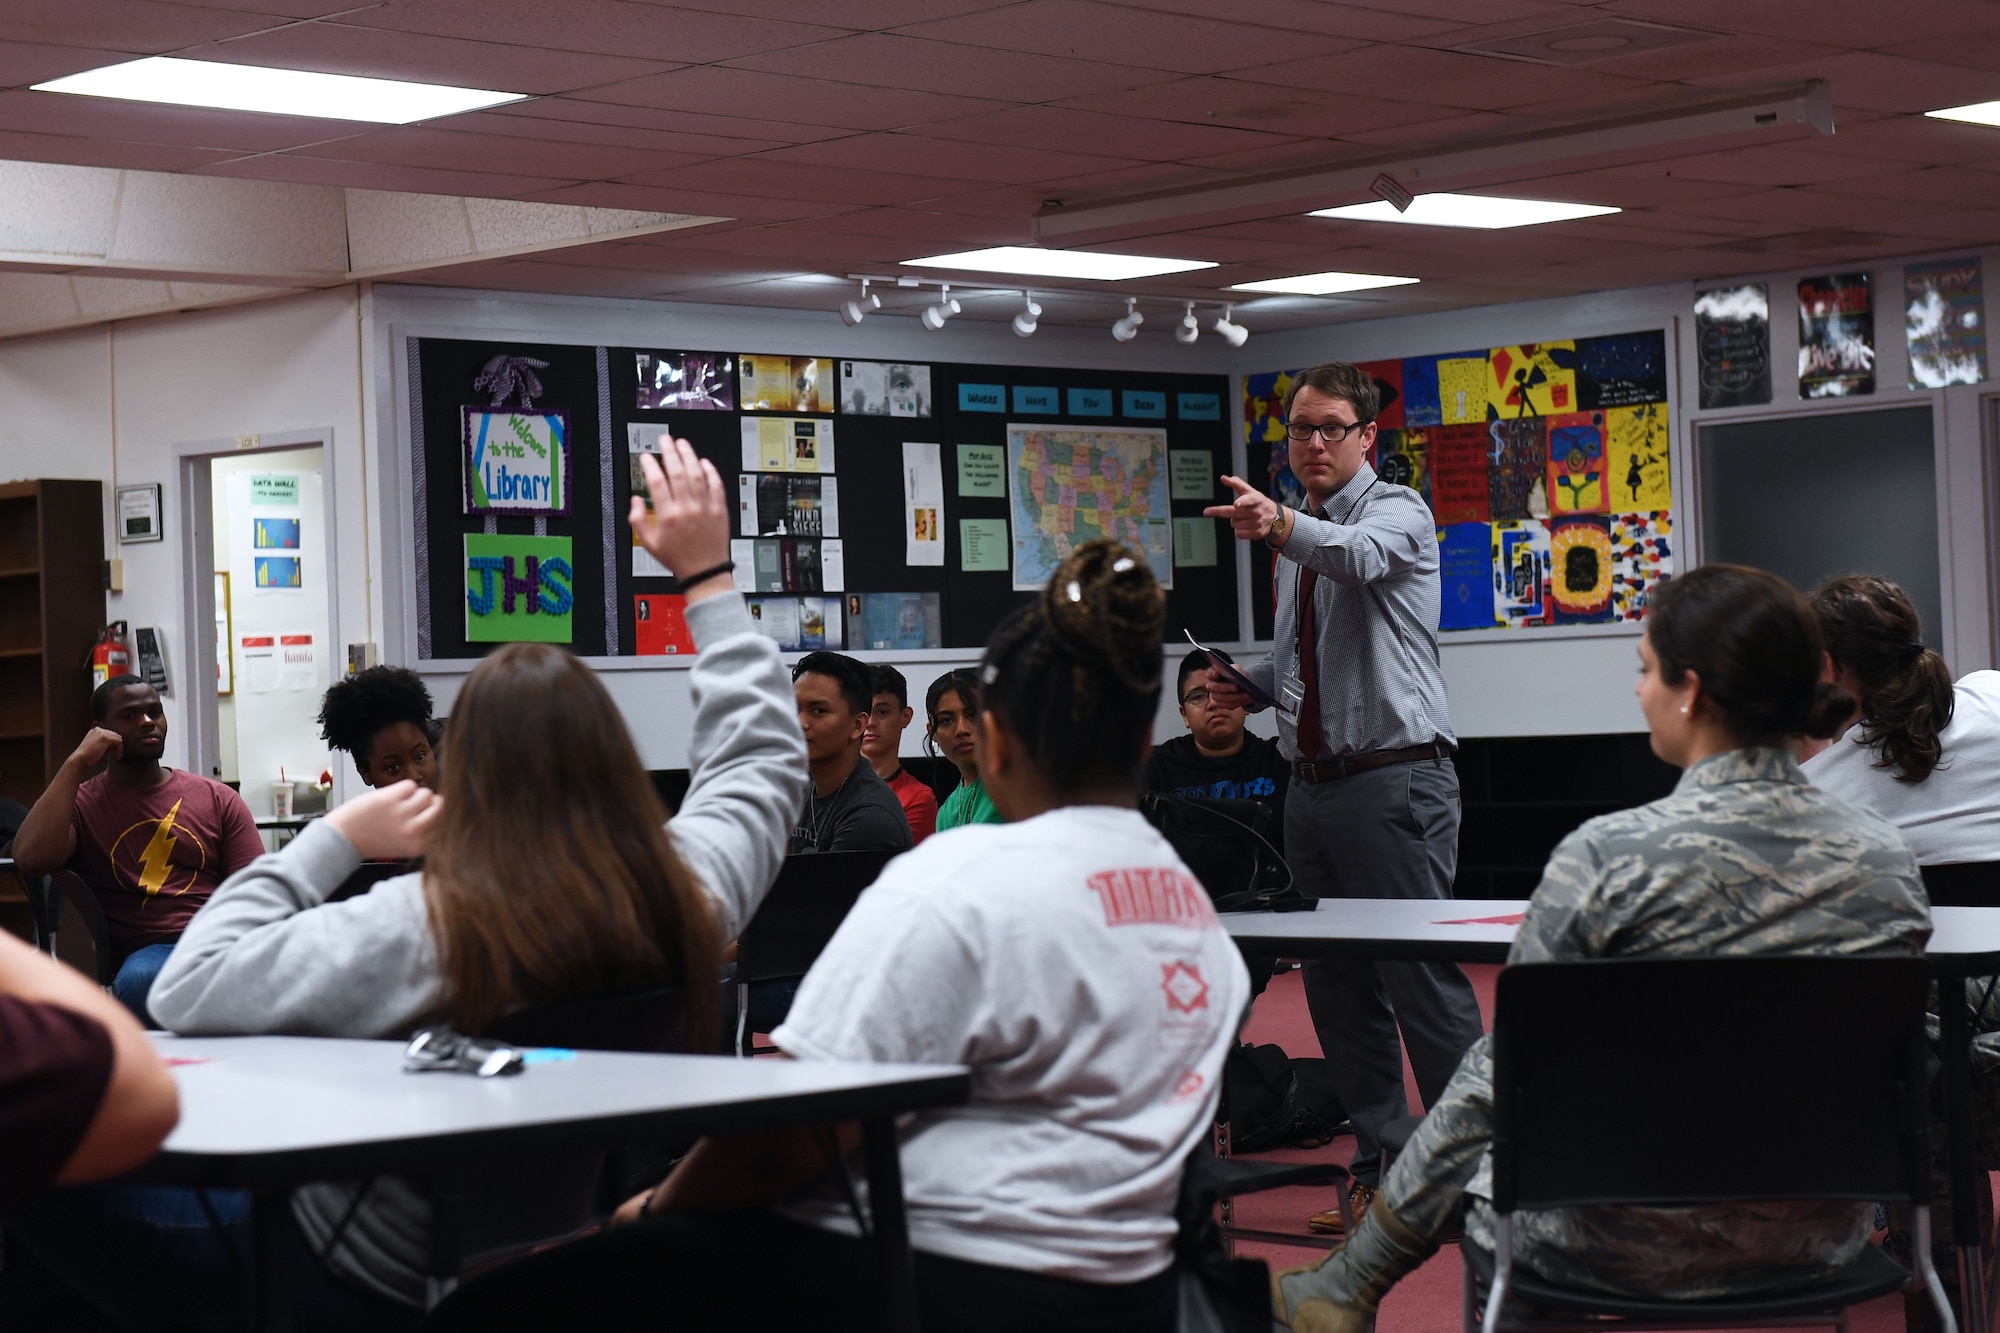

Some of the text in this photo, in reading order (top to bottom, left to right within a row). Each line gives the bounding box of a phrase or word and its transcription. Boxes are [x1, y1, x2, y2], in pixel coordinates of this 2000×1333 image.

[967, 393, 998, 405] WHERE
[1025, 396, 1048, 407] HAVE
[1083, 397, 1099, 408] YOU
[508, 412, 547, 459] Welcome
[488, 440, 525, 458] to the
[274, 480, 296, 488] WALL
[485, 461, 551, 502] Library
[794, 509, 819, 521] MIND
[467, 555, 573, 616] JHS
